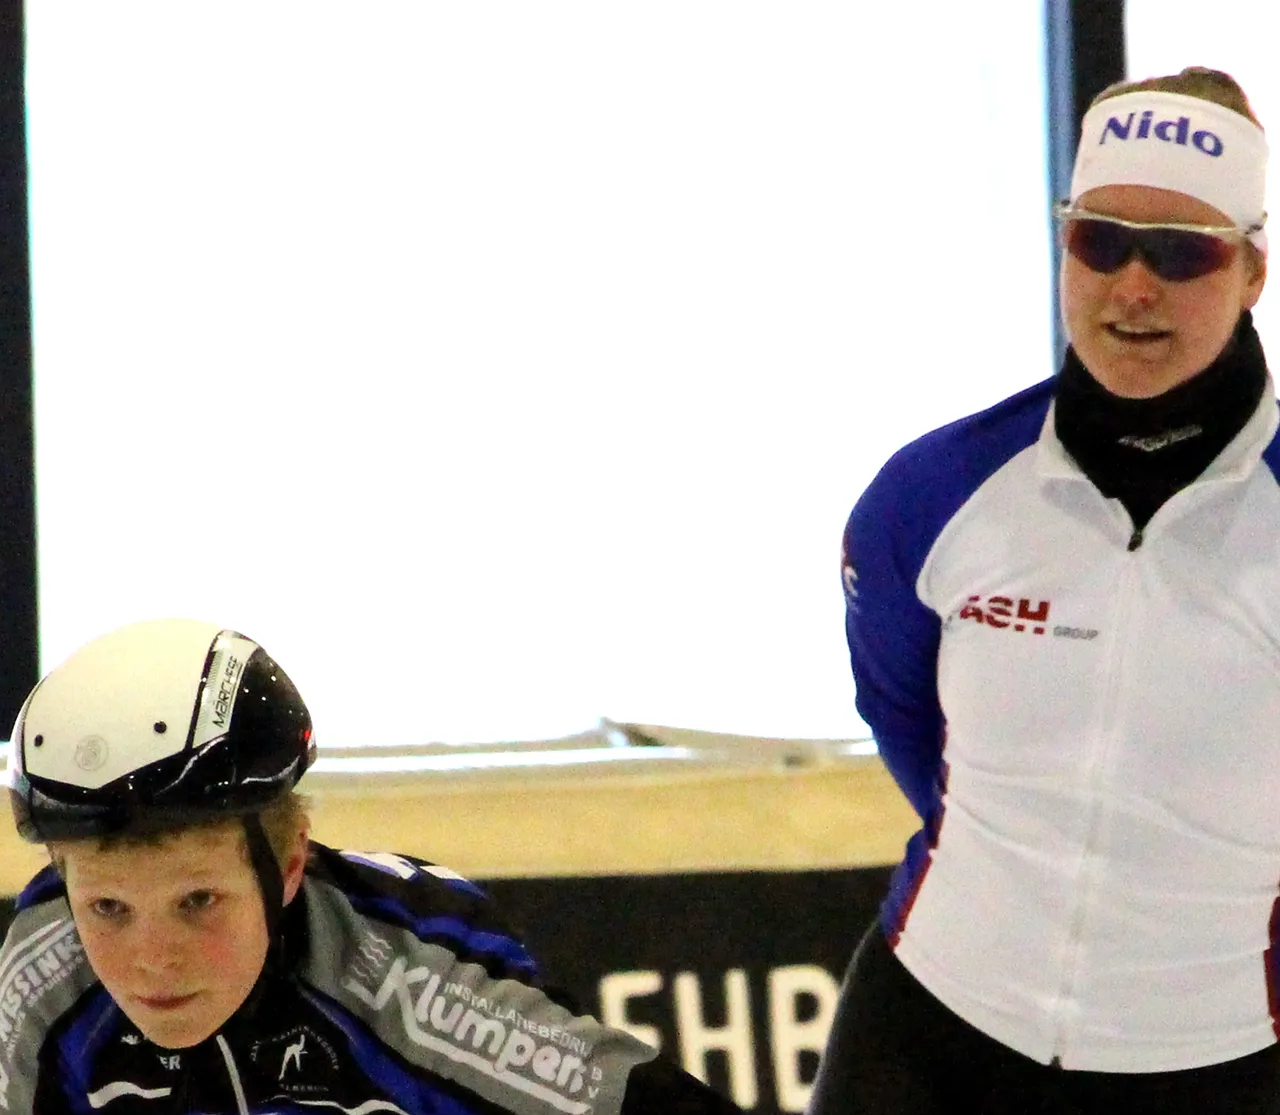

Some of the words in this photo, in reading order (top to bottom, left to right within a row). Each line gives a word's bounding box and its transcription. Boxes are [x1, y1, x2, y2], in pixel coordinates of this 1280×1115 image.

[1099, 110, 1224, 157] Nido
[959, 595, 1050, 635] ASH
[1053, 625, 1099, 640] GROUP
[344, 957, 592, 1115] Klumpers
